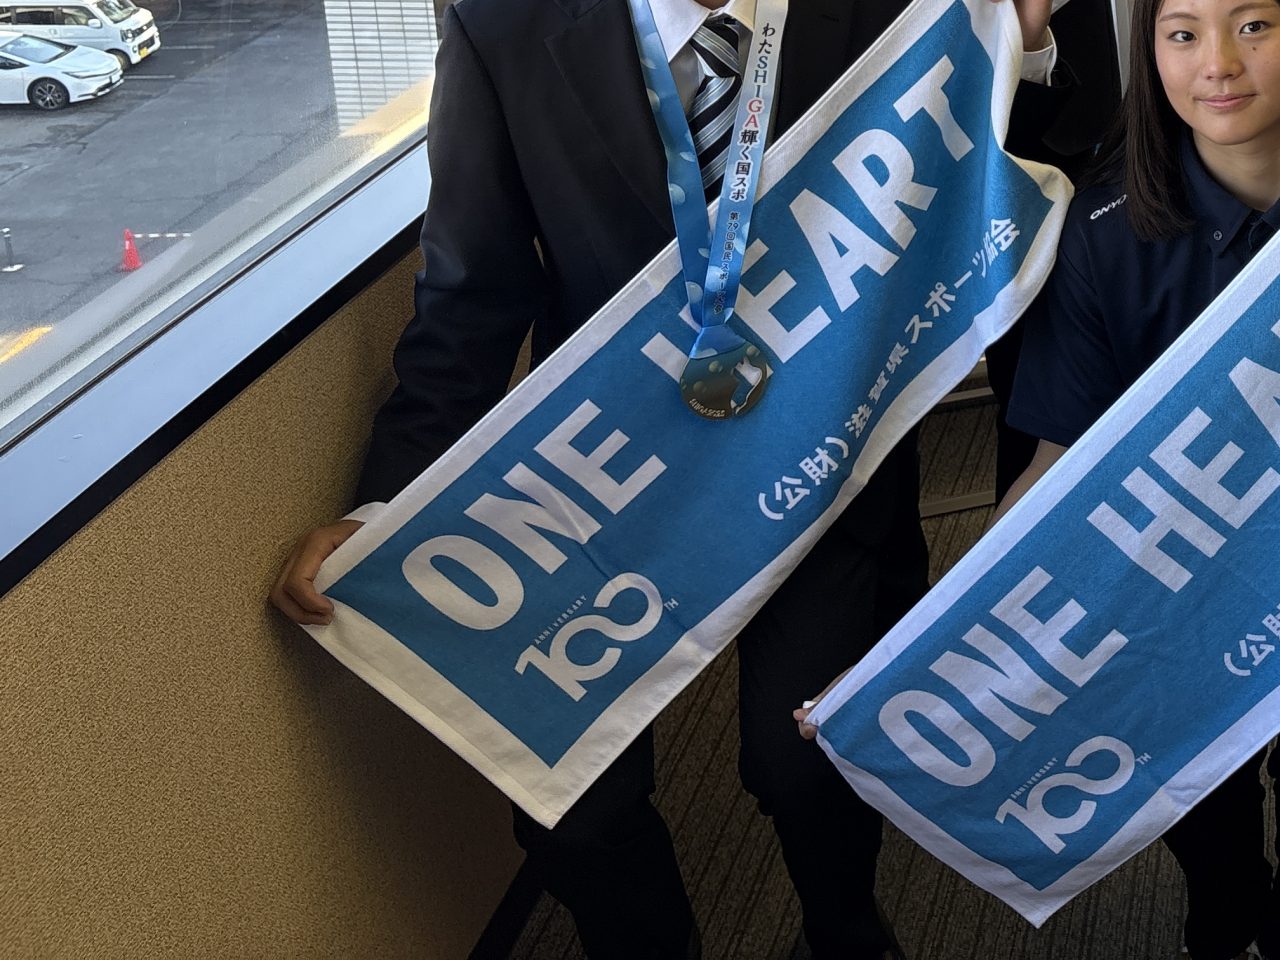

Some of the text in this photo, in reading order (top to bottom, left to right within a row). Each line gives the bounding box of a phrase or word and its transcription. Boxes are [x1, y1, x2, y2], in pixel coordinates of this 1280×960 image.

[730, 22, 777, 202] わたSHIGA輝く国スポ
[759, 219, 1020, 520] (公財)滋賀県スポーツ協会
[400, 400, 667, 632] ONE
[534, 594, 587, 645] ANNIVERSARY
[879, 567, 1128, 787] ONE
